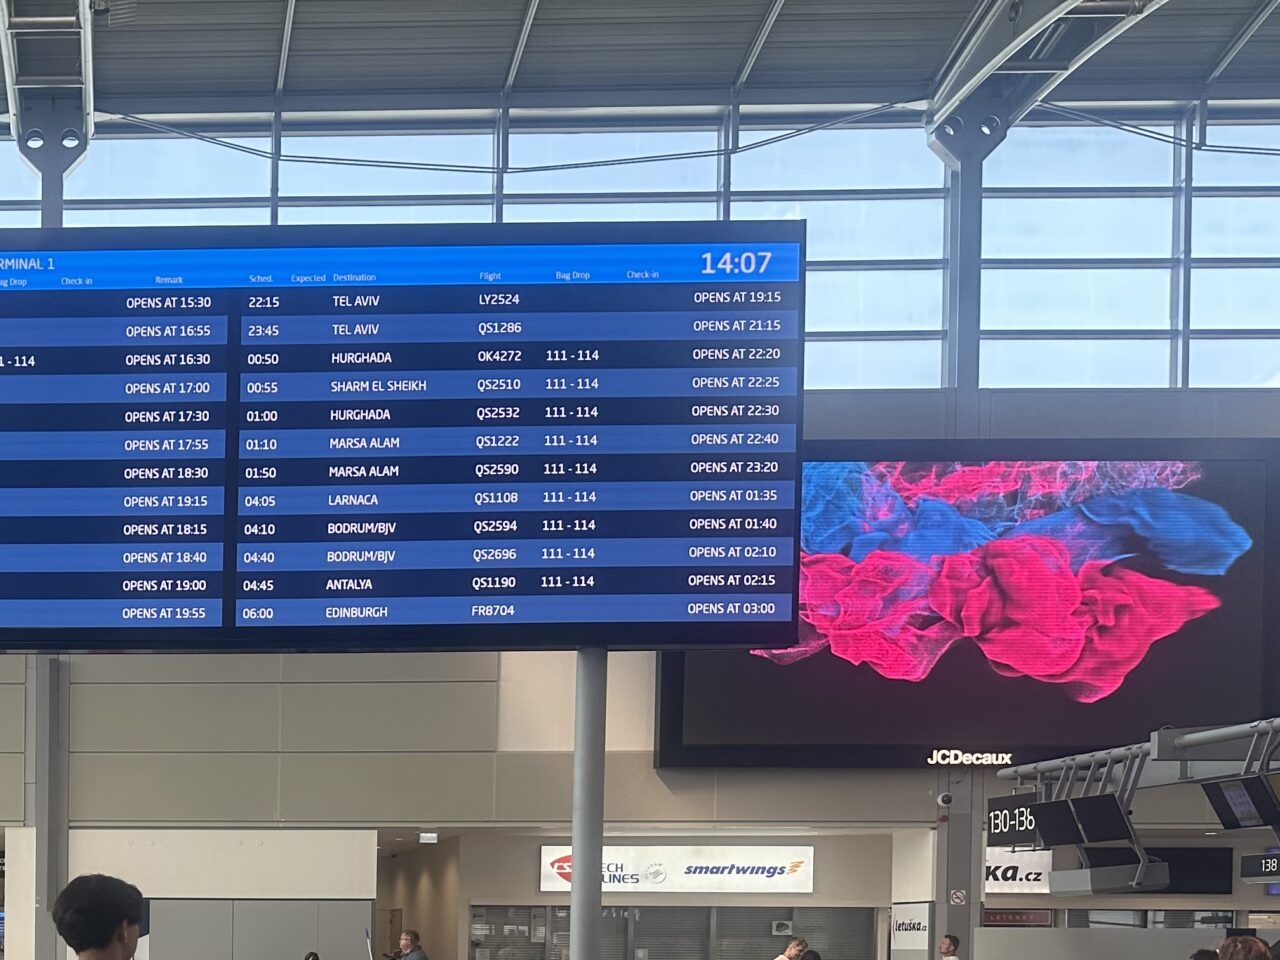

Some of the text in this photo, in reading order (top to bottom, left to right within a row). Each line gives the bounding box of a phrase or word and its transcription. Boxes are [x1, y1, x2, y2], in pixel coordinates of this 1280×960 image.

[47, 257, 55, 270] 1
[701, 251, 773, 274] 14:07
[290, 274, 327, 284] Expected
[479, 271, 502, 282] Flight
[332, 293, 520, 307] TEL AVIV LY2524
[331, 322, 522, 336] TEL AVIV QS1286
[331, 350, 522, 364] HURGHADA OK4272
[330, 378, 521, 393] SHARM EL SHEIKH QS2510
[330, 406, 520, 421] HURGHADA QS2532
[329, 435, 520, 449] MARSA ALAM QS1222
[328, 463, 520, 478] MARSA ALAM QS2590
[328, 492, 519, 506] LARNACA QS1108
[327, 520, 518, 536] BODRUM/BJV QS2594
[327, 550, 396, 564] BODRUM/BJV
[325, 576, 516, 591] ANTALYA QS1190
[325, 605, 515, 619] EDINBURGH FR8704
[926, 749, 1013, 765] JCDecaux
[683, 863, 787, 879] smartwings
[1261, 858, 1278, 872] 138
[602, 873, 640, 884] LINES
